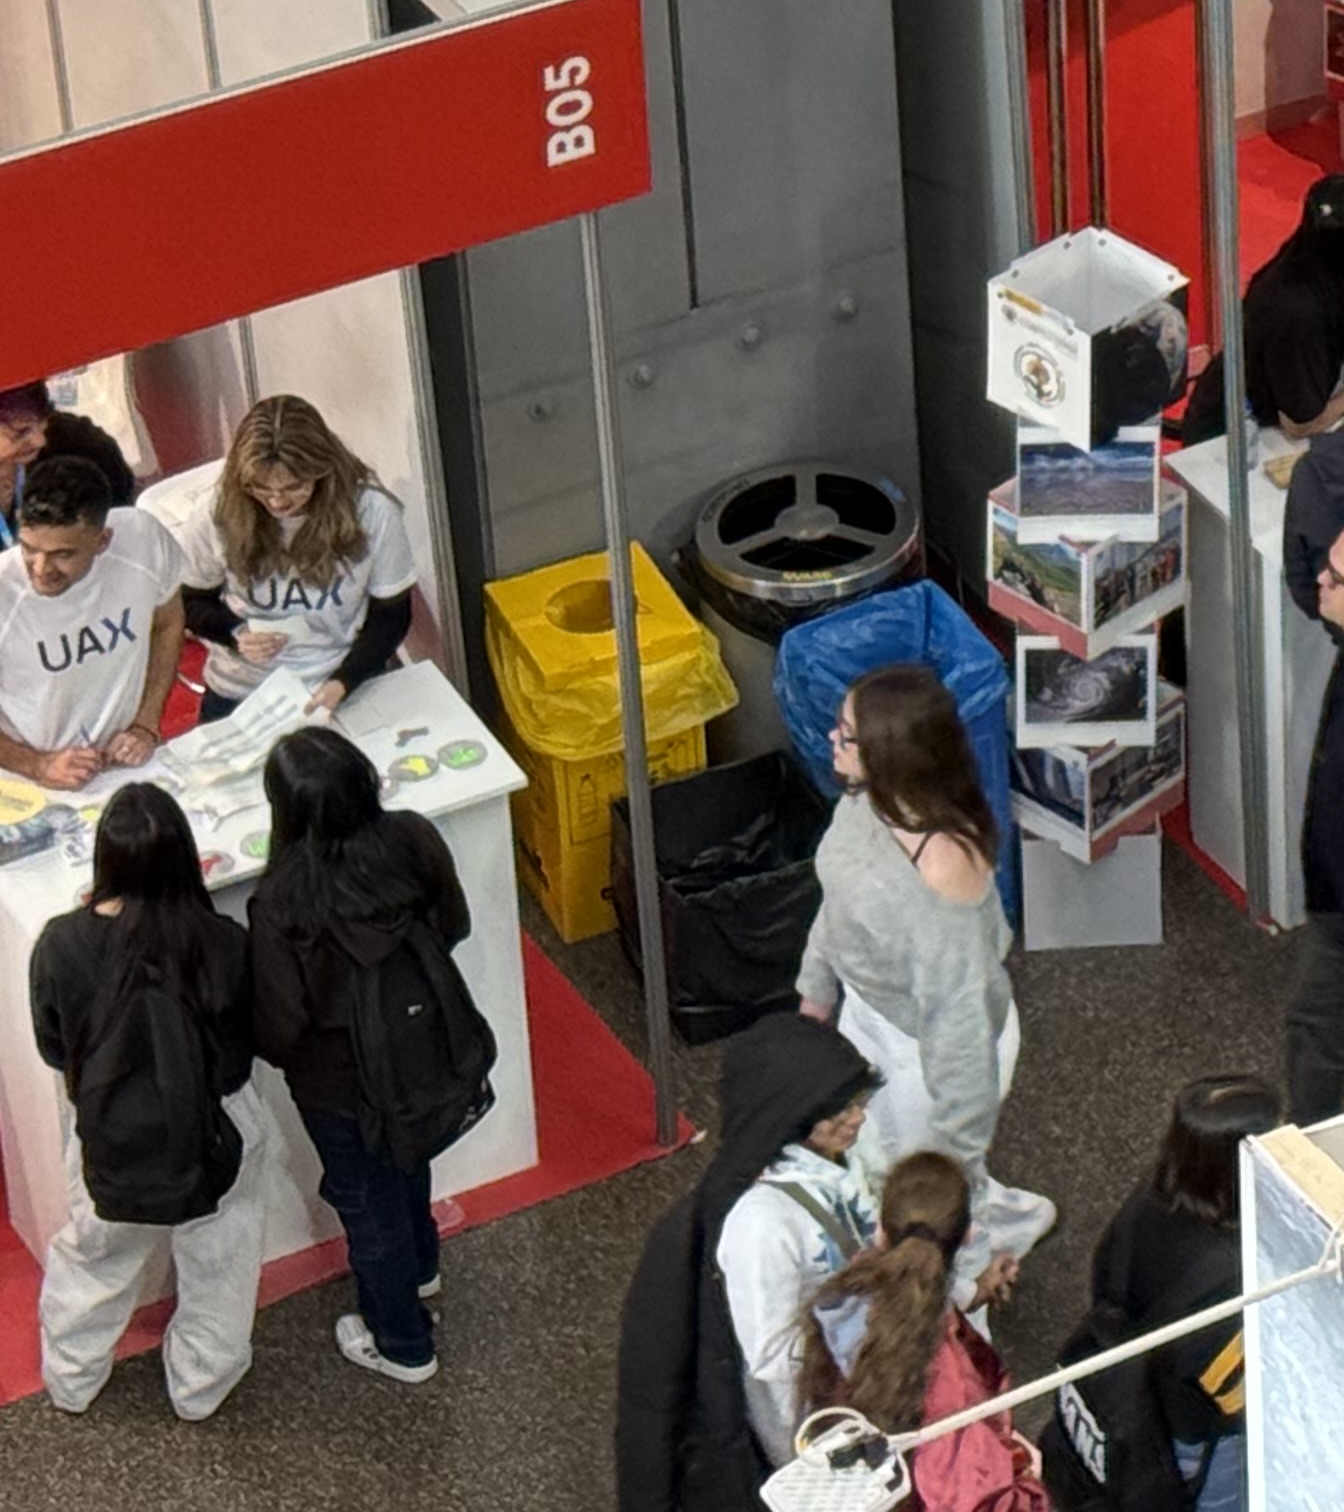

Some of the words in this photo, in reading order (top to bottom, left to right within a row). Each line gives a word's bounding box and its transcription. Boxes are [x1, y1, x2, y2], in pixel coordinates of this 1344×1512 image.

[543, 53, 596, 169] B05
[246, 576, 345, 613] UAX
[35, 606, 138, 674] UAX
